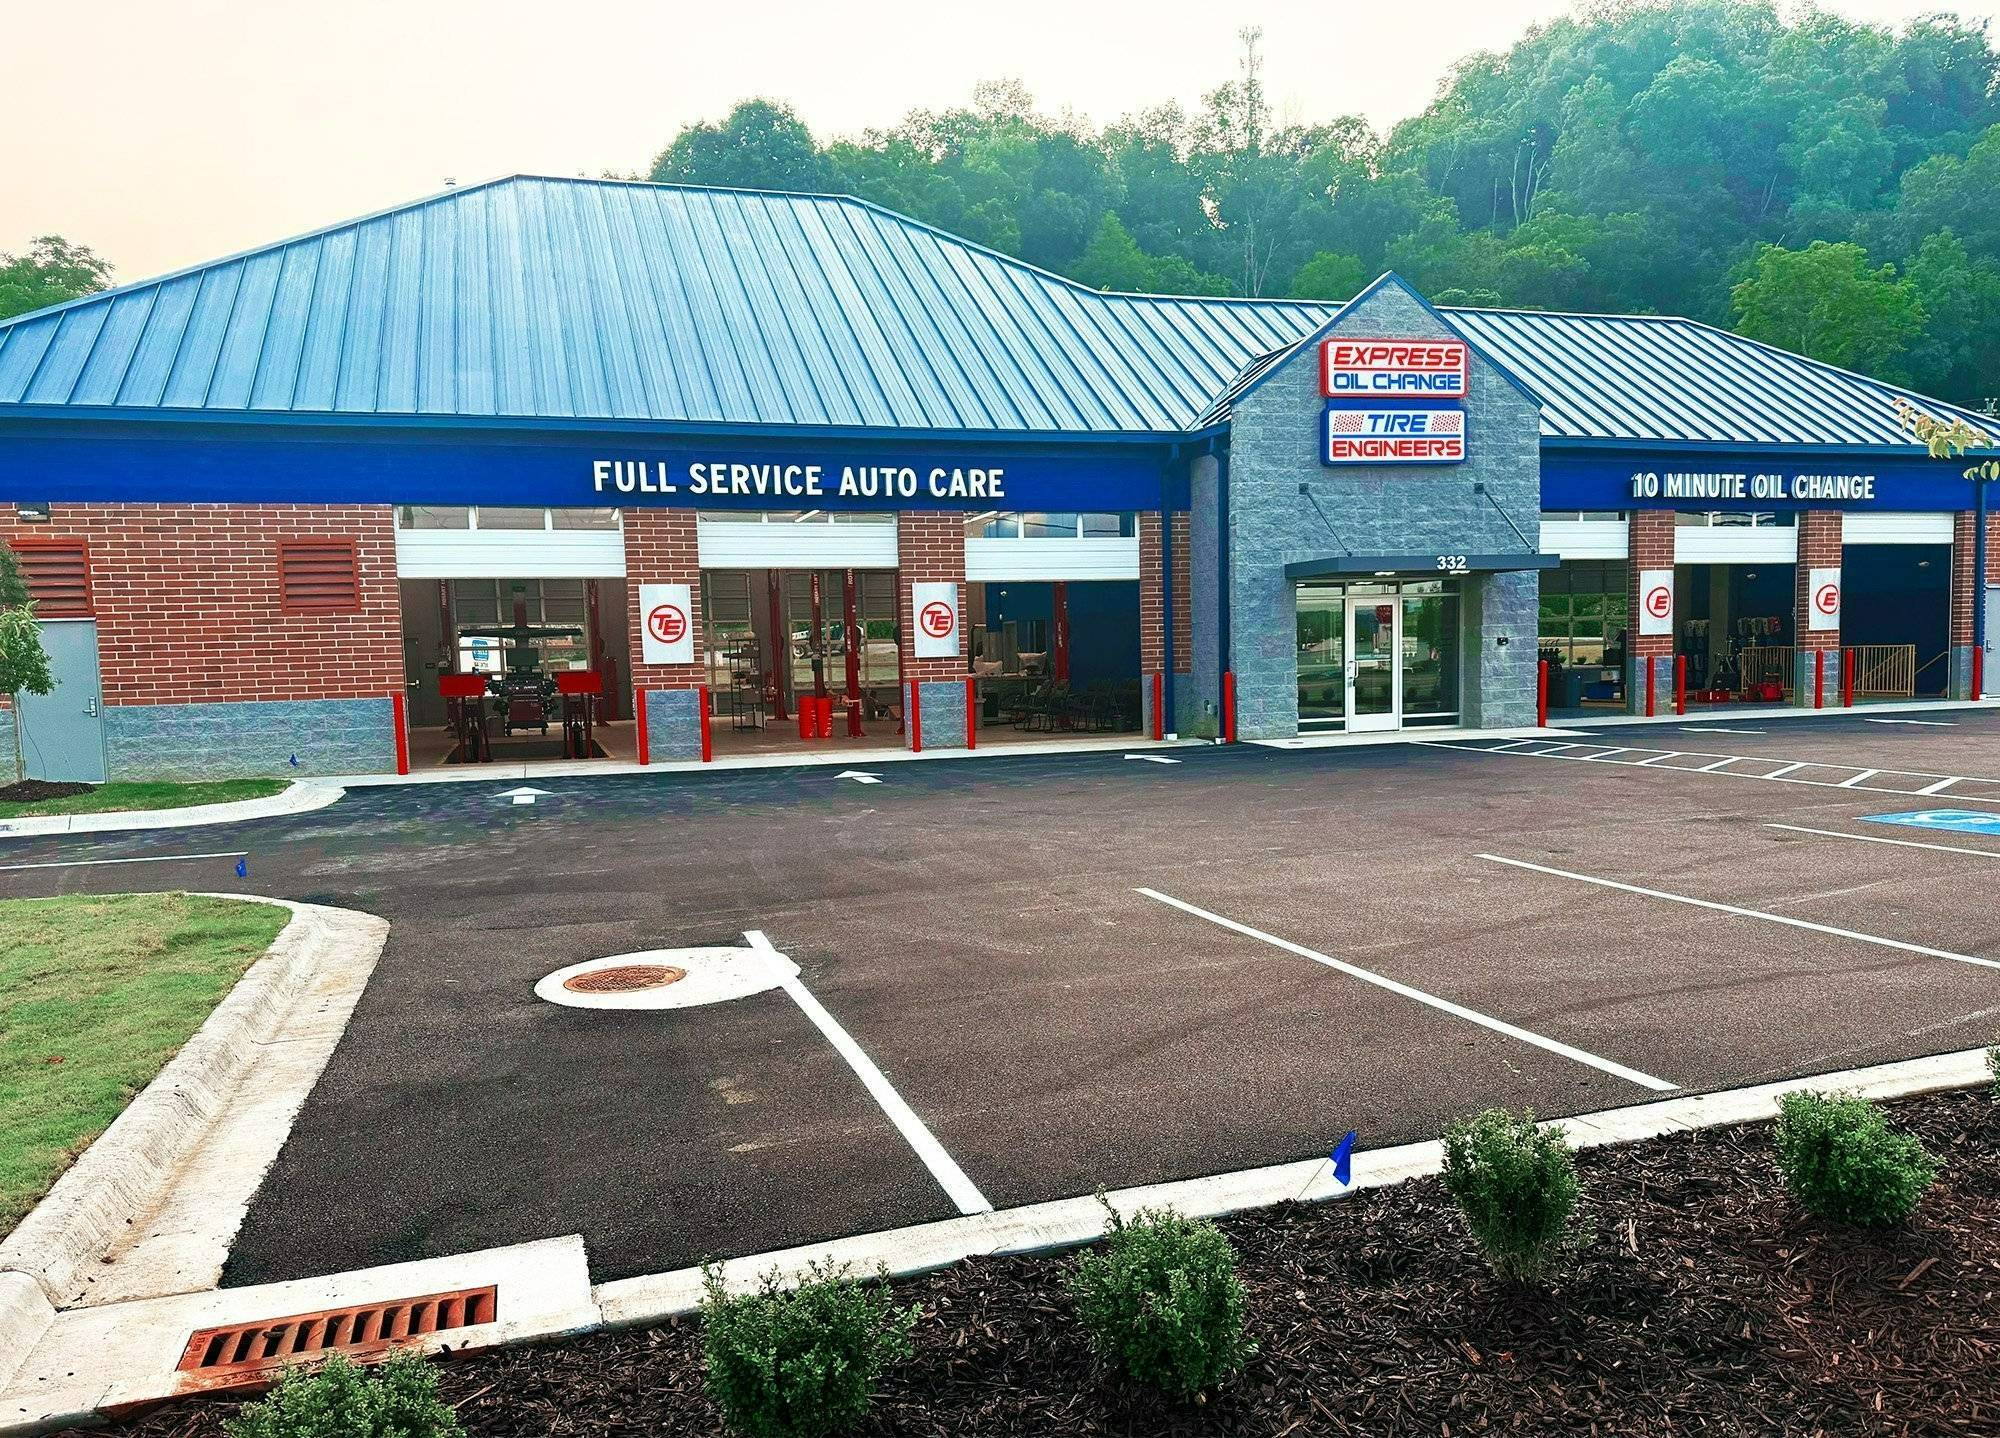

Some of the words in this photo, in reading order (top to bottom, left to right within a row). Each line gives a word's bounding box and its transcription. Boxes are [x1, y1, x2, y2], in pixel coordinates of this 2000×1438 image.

[1333, 346, 1463, 366] EXPRESS
[1333, 373, 1368, 389] OIL
[1373, 373, 1461, 390] CHANGE
[1367, 414, 1428, 432] TIRE
[1332, 440, 1461, 457] ENGINEERS
[593, 460, 677, 493] FULL
[689, 463, 825, 496] SERVICE
[838, 466, 917, 497] AUTO
[929, 468, 1005, 498] CARE
[1631, 473, 1659, 498] 10
[1663, 473, 1746, 498] MINUTE
[1751, 474, 1788, 499] OIL
[1792, 475, 1875, 499] CHANGE
[1437, 555, 1467, 570] 332
